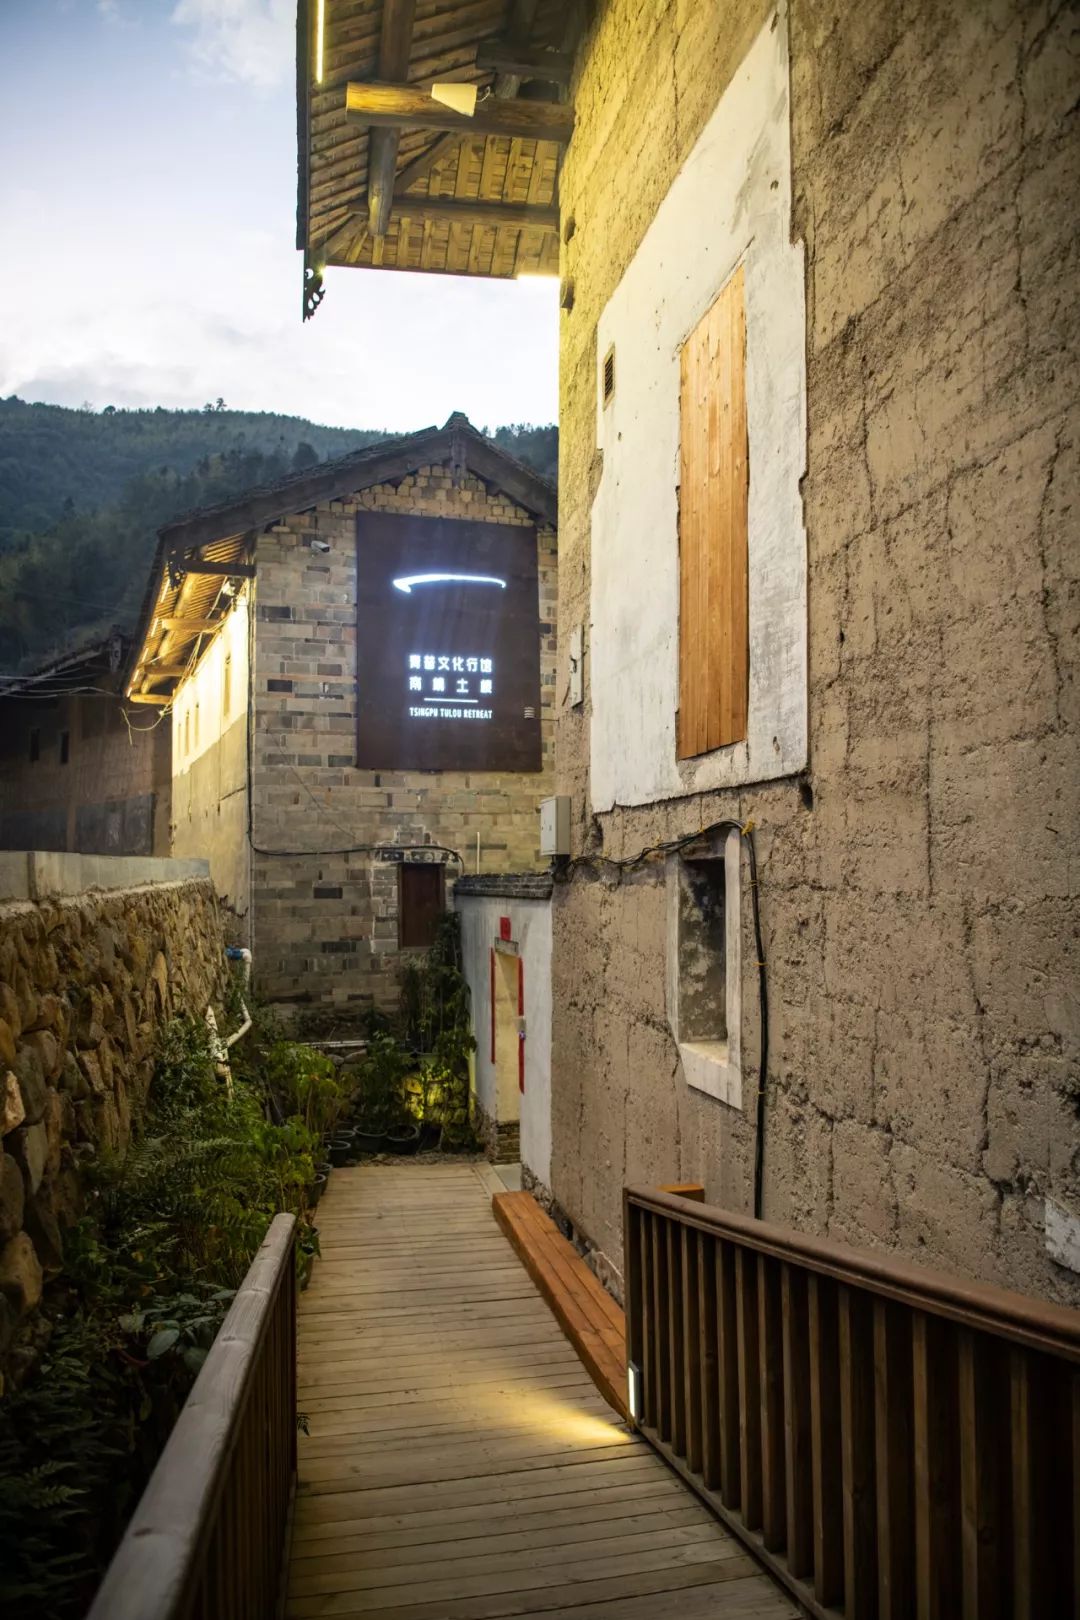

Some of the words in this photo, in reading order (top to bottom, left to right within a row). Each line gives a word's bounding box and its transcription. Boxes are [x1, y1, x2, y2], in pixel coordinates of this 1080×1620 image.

[408, 706, 438, 717] TSINGPU
[439, 707, 462, 718] TULOU
[463, 708, 493, 719] RETREAT
